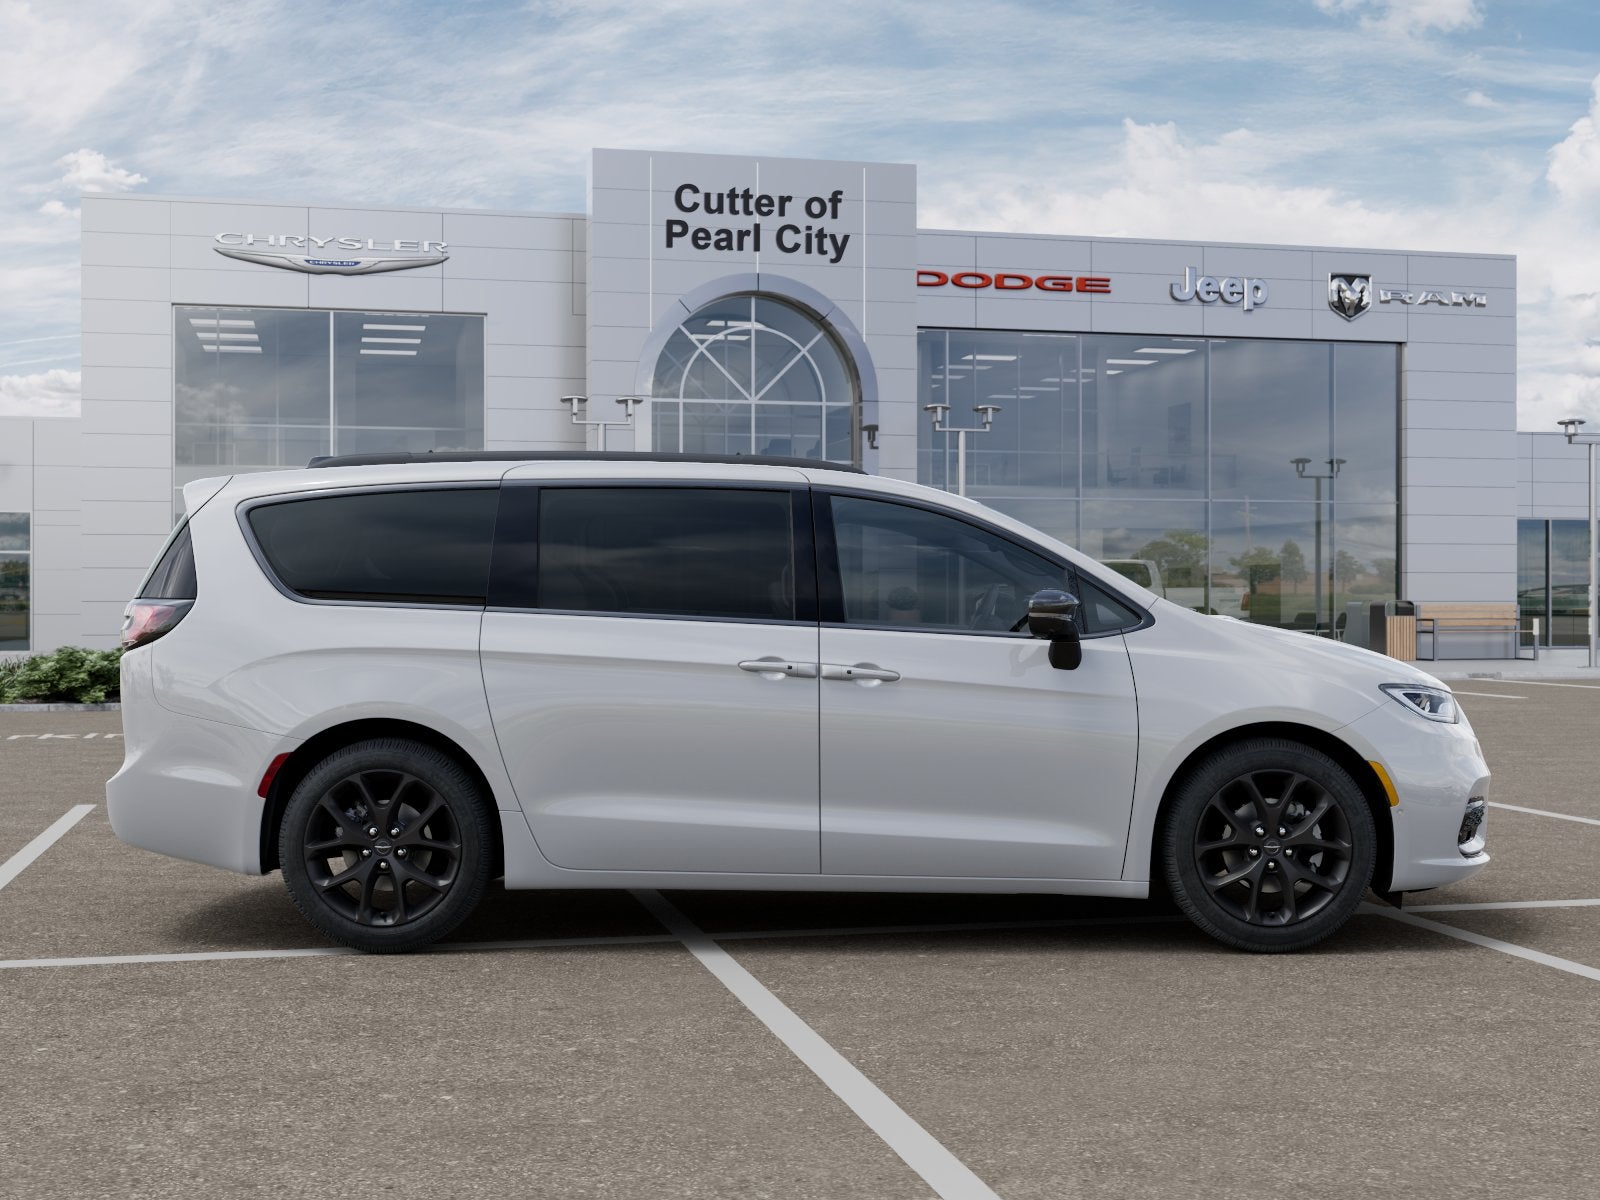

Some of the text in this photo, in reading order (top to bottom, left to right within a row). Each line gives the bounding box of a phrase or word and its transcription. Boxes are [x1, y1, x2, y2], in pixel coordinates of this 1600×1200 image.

[674, 183, 844, 219] Cutter of
[214, 232, 449, 254] CHRYSLER
[665, 219, 850, 264] Pearl City
[916, 270, 1112, 294] DODGE
[1170, 266, 1269, 312] Jeep
[1379, 288, 1488, 308] RAM
